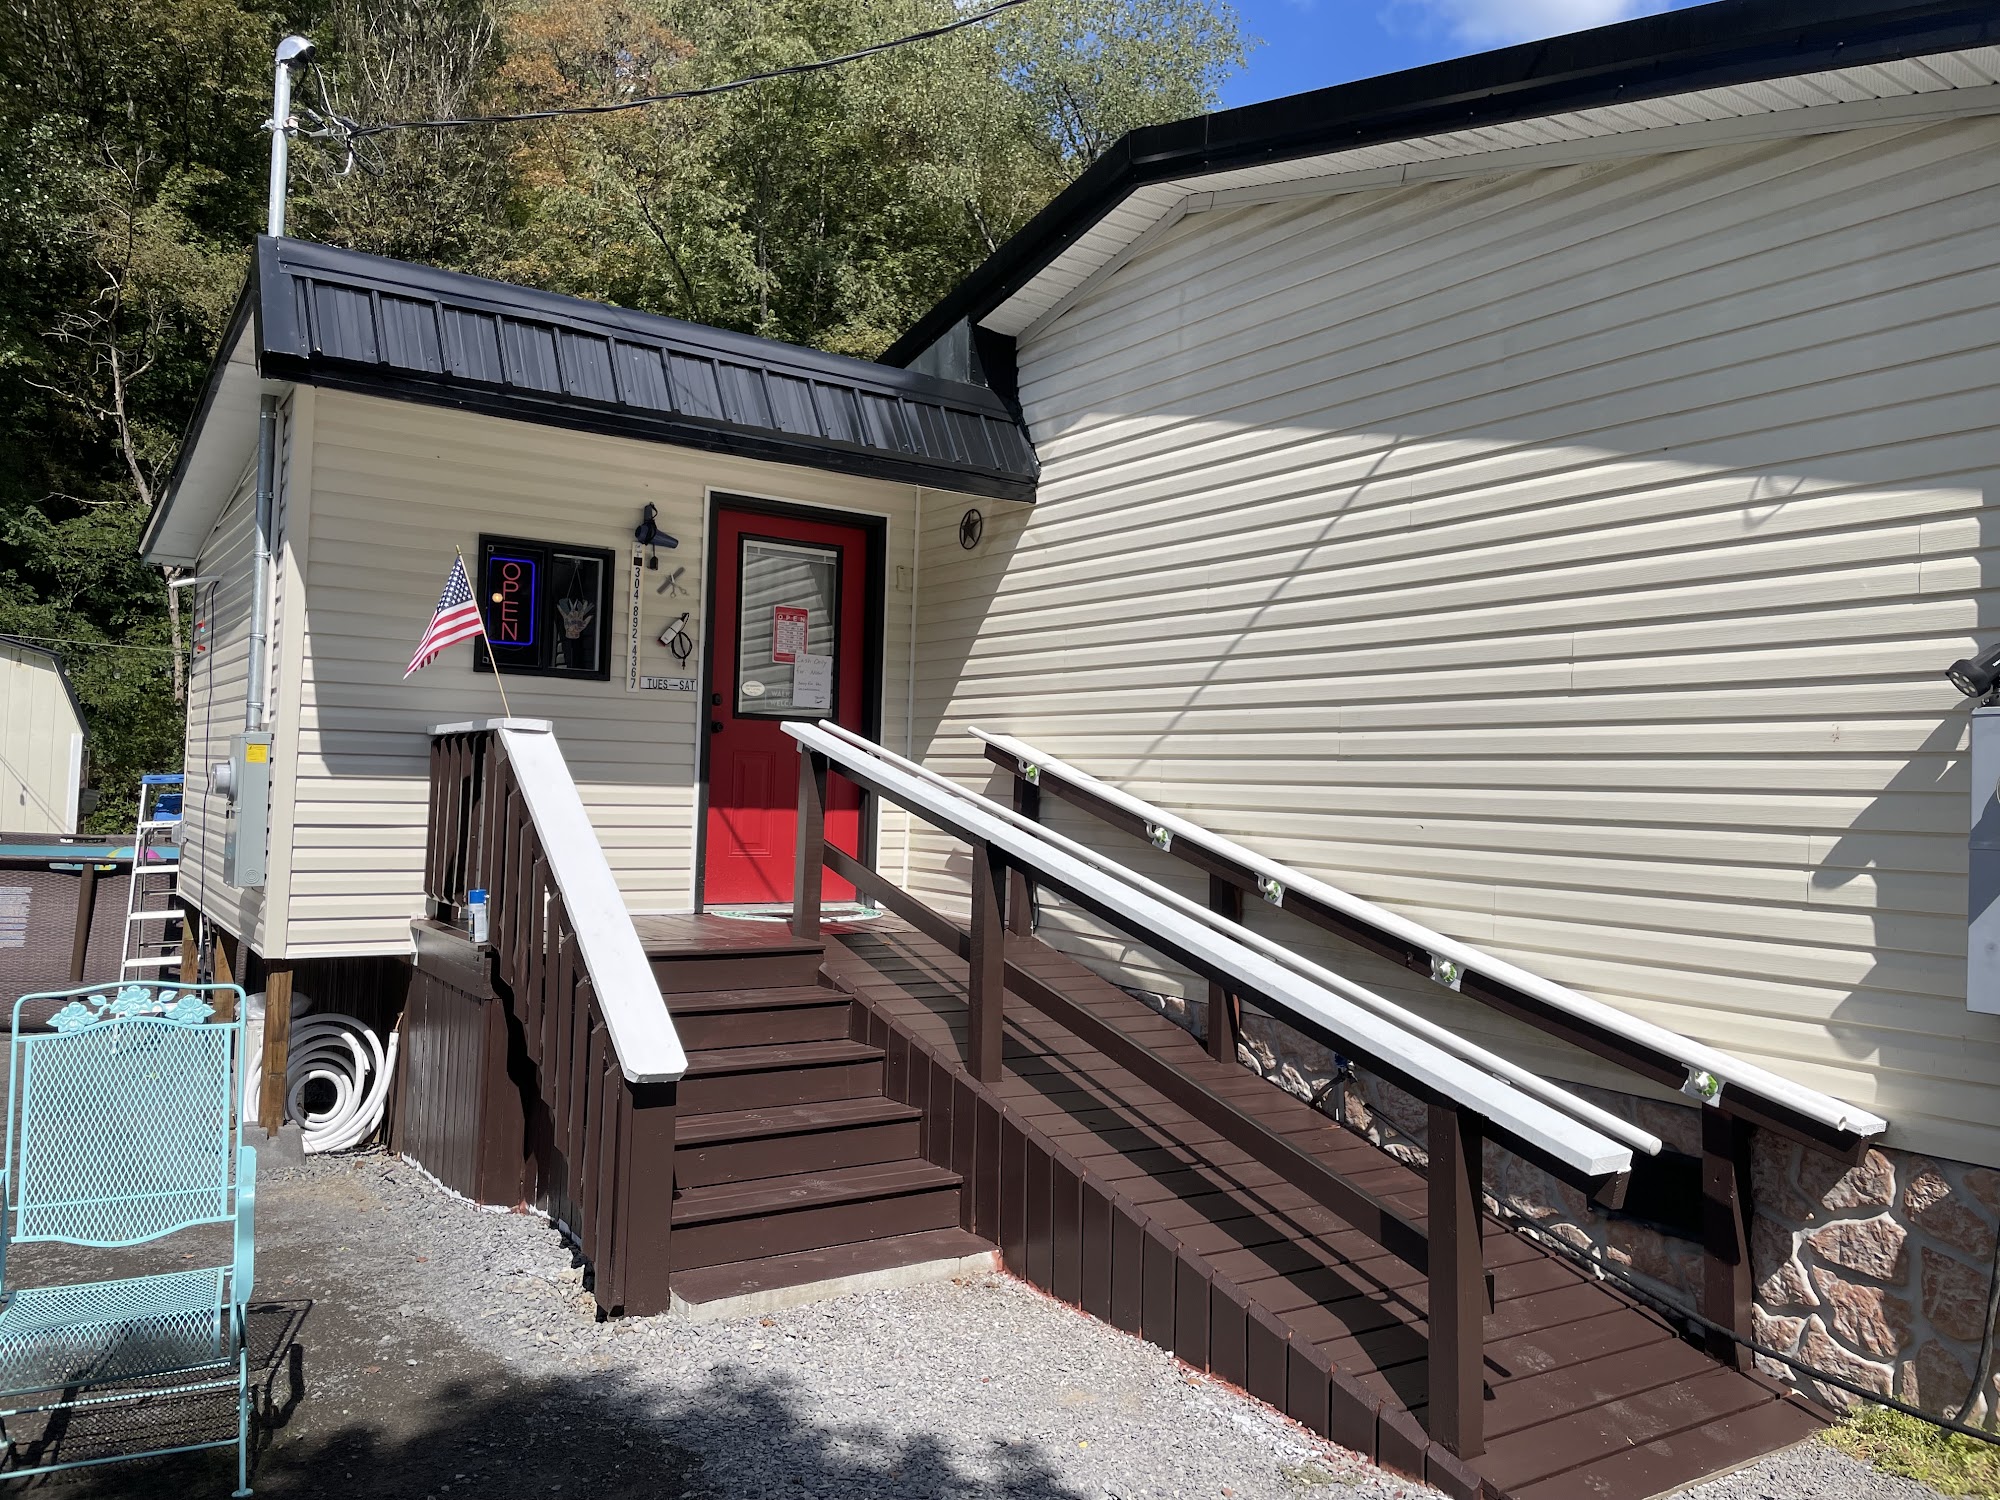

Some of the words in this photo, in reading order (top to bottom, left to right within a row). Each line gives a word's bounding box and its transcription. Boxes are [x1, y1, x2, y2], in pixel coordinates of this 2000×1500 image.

[501, 563, 521, 641] OPEN
[778, 614, 805, 623] OPEN
[770, 699, 793, 708] WELCO
